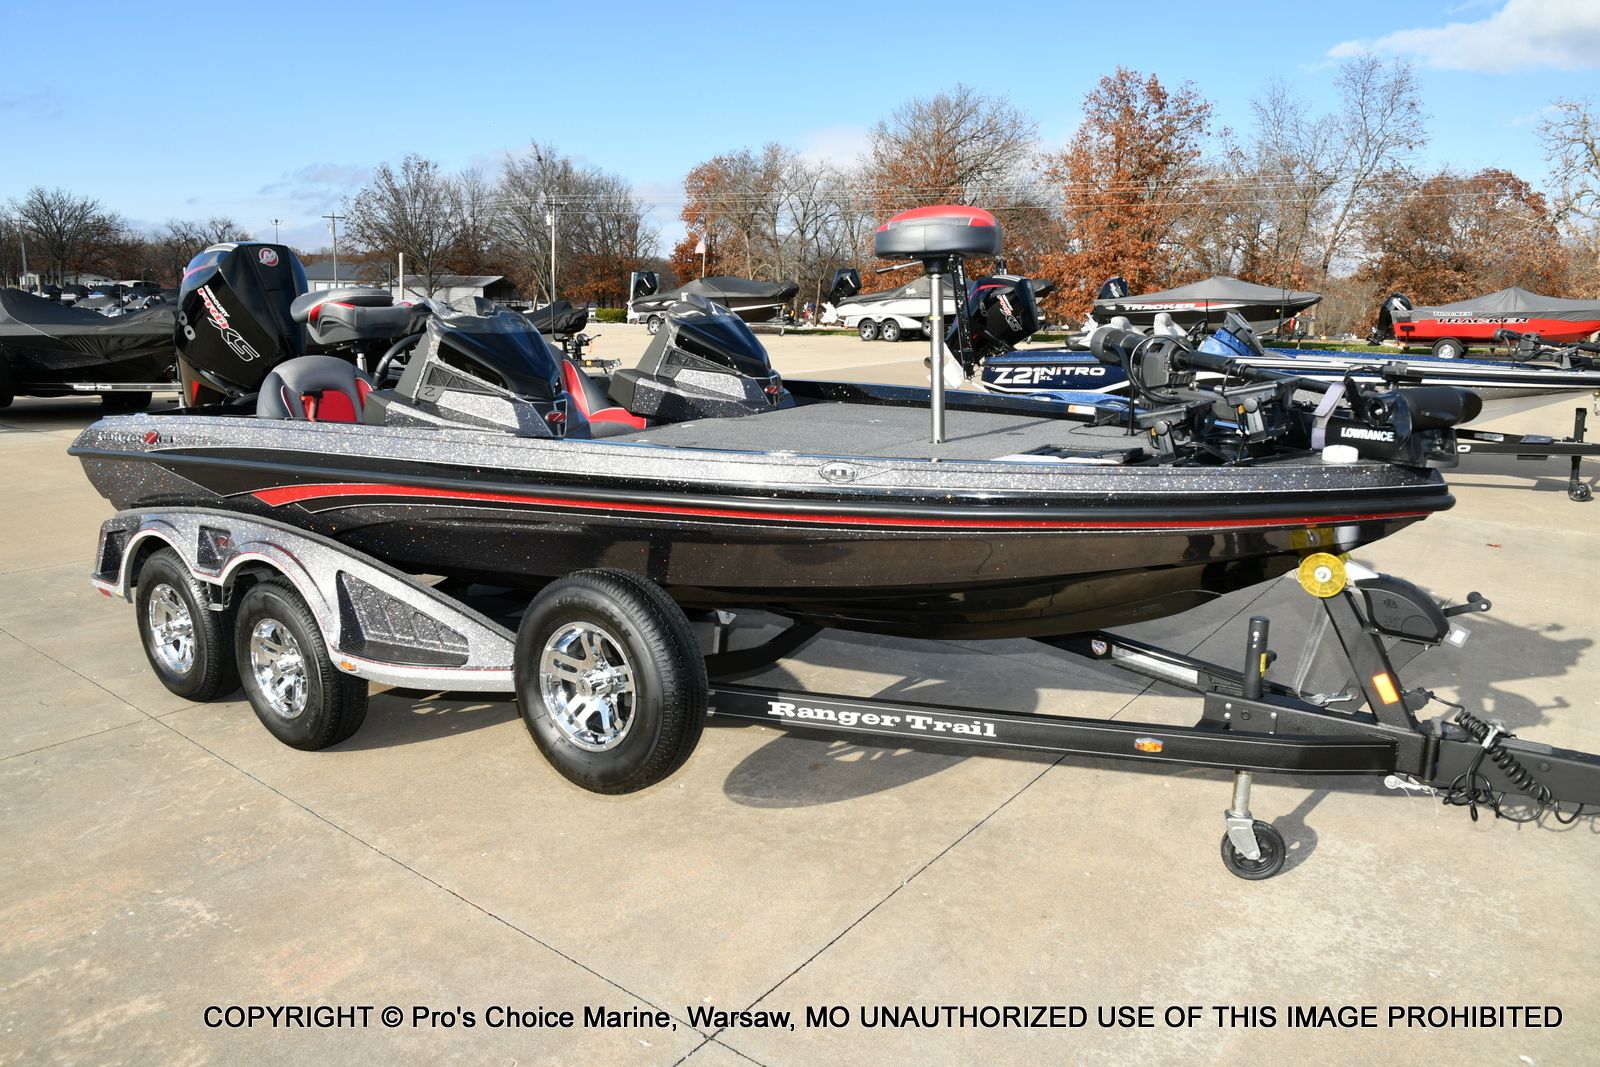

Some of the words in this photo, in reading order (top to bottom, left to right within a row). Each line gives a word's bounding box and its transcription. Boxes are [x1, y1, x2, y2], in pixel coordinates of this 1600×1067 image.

[197, 287, 229, 329] PRO
[204, 285, 230, 317] MERCURY
[207, 316, 260, 361] XS
[993, 366, 1040, 384] Z21
[1040, 366, 1106, 376] NITRO
[1341, 427, 1395, 442] LOWRANCE
[767, 701, 901, 727] Ranger
[905, 714, 997, 738] Trail
